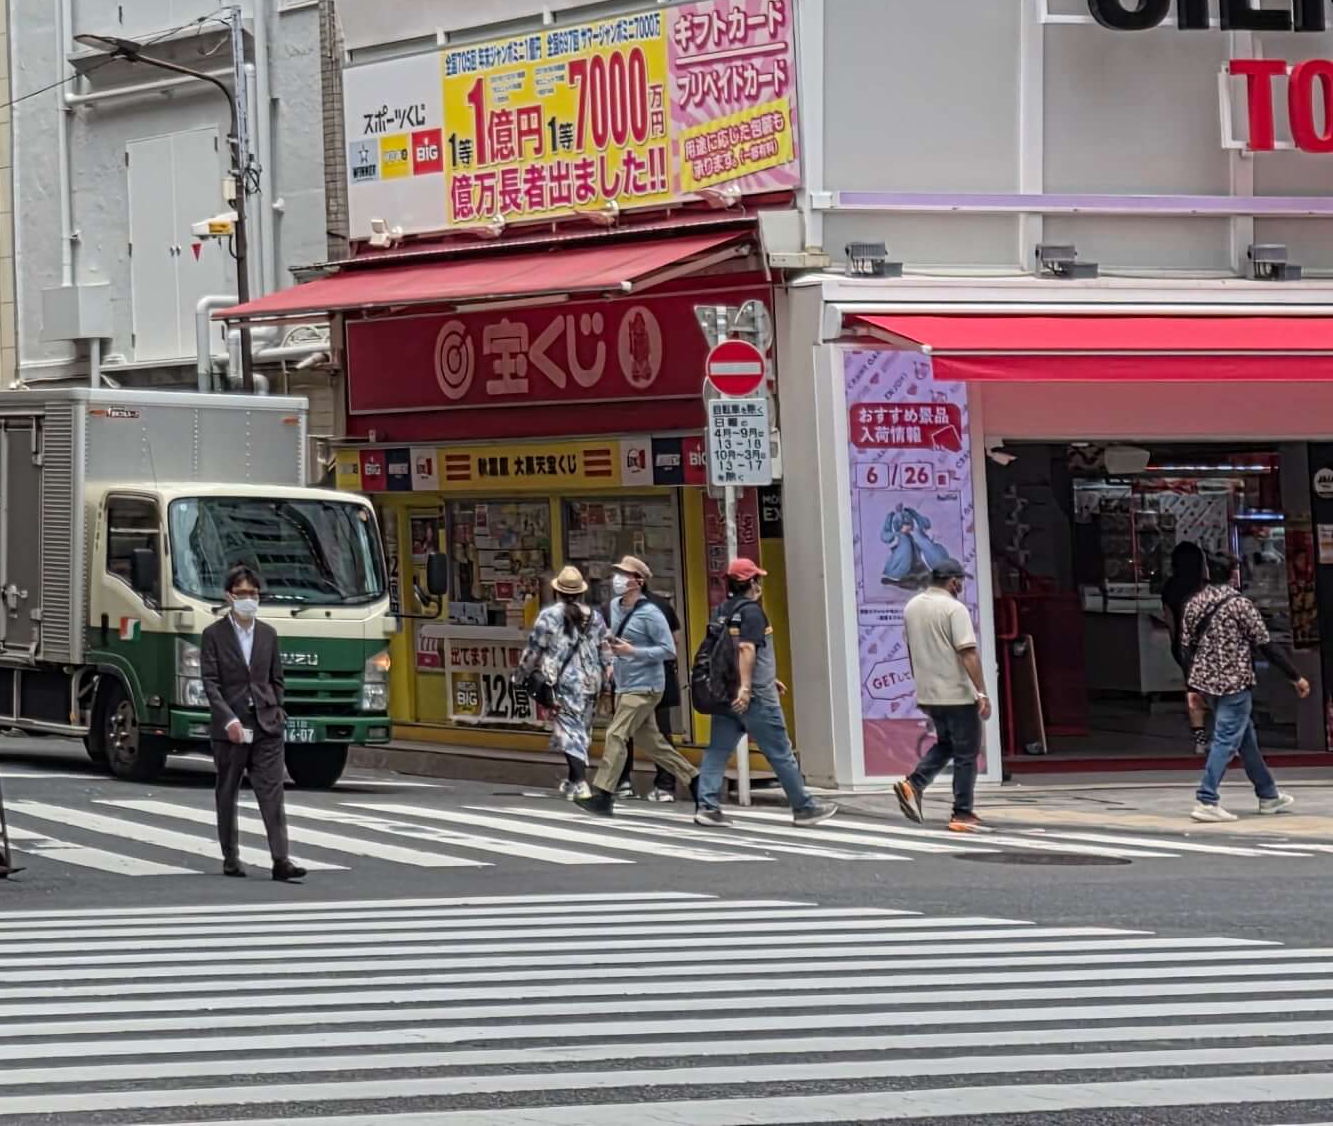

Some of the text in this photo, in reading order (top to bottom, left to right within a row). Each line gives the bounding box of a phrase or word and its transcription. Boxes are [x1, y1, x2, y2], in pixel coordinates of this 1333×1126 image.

[674, 0, 786, 52] ギフトカード
[676, 59, 787, 109] プリペイドカード
[363, 104, 426, 135] スポーツくじ
[483, 311, 605, 396] 宝くじ
[859, 406, 949, 424] おすすめ景品
[860, 426, 922, 443] 入荷情報
